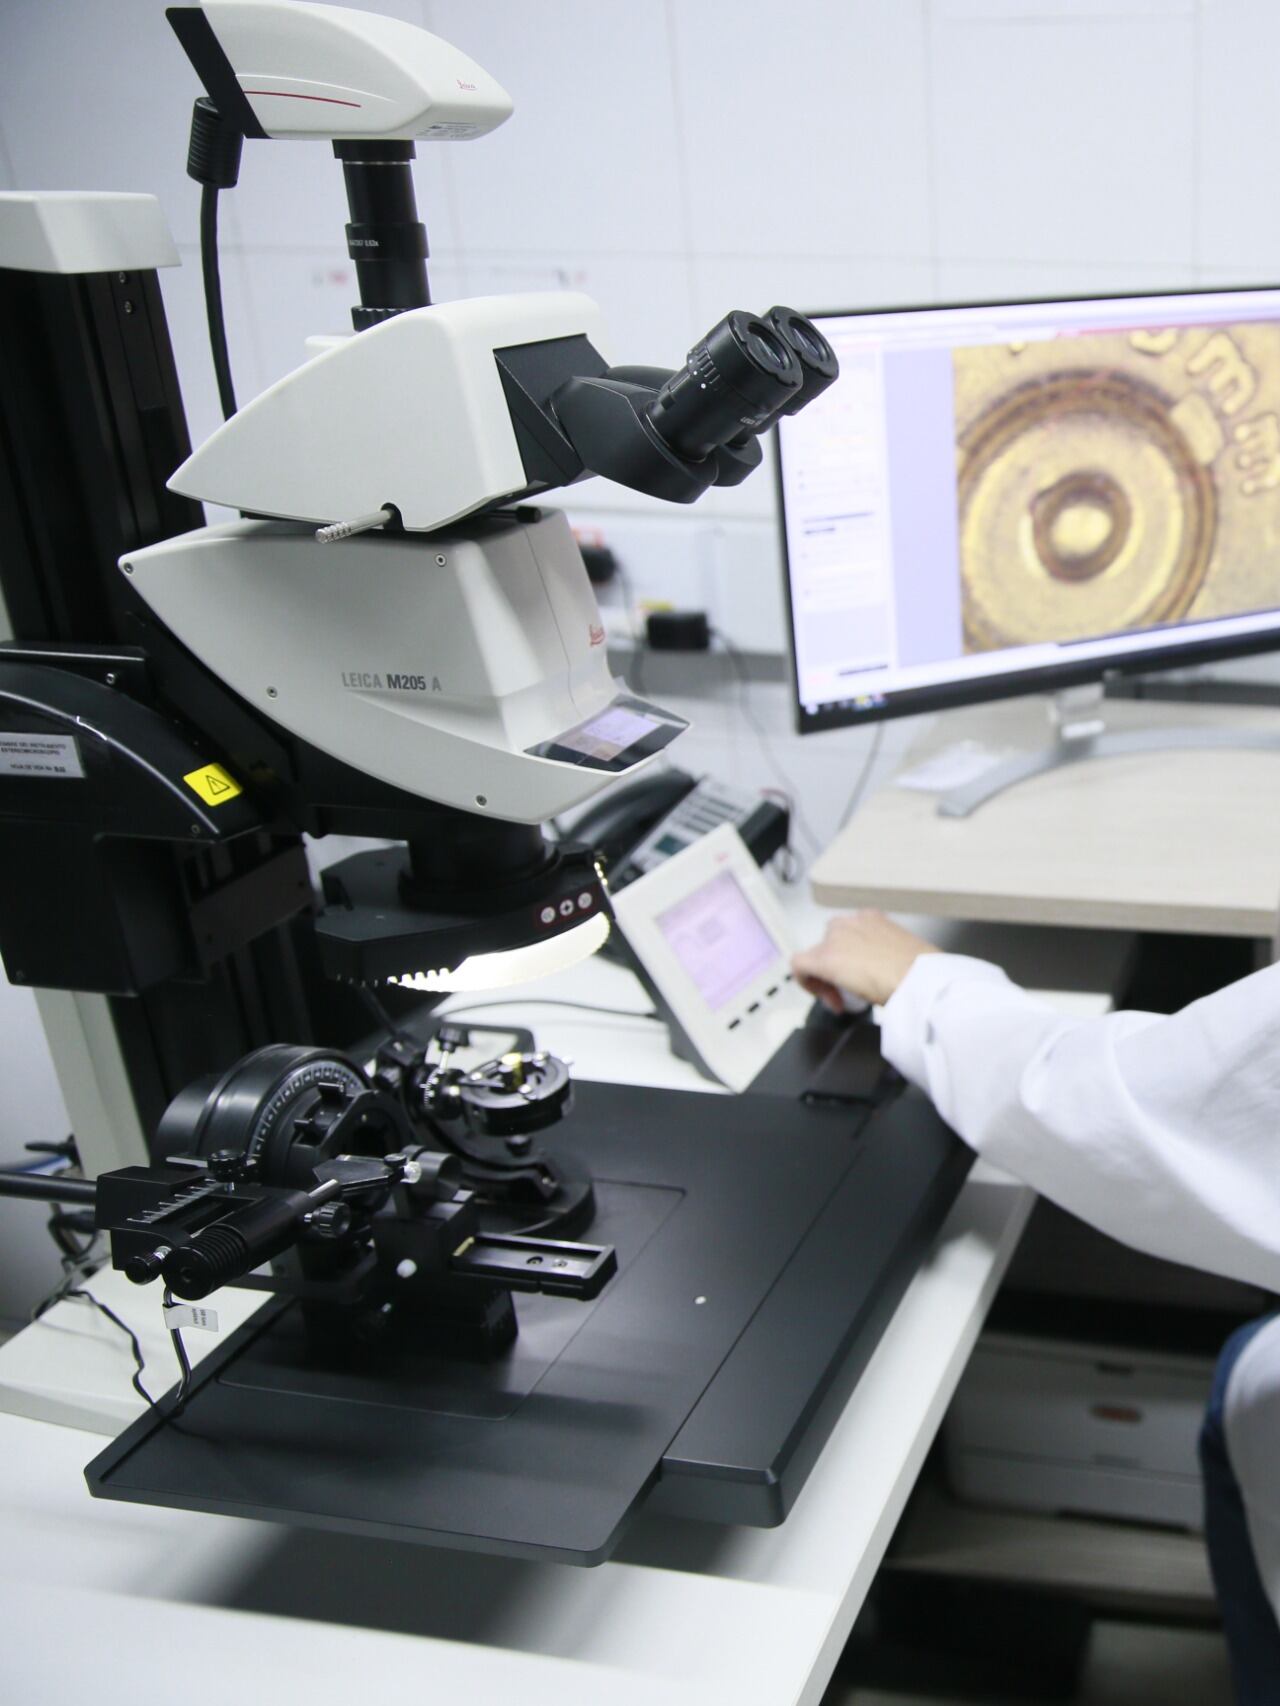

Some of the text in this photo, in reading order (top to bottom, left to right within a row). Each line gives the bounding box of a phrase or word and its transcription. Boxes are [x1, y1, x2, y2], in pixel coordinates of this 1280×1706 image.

[341, 672, 442, 691] LEICA M205 A
